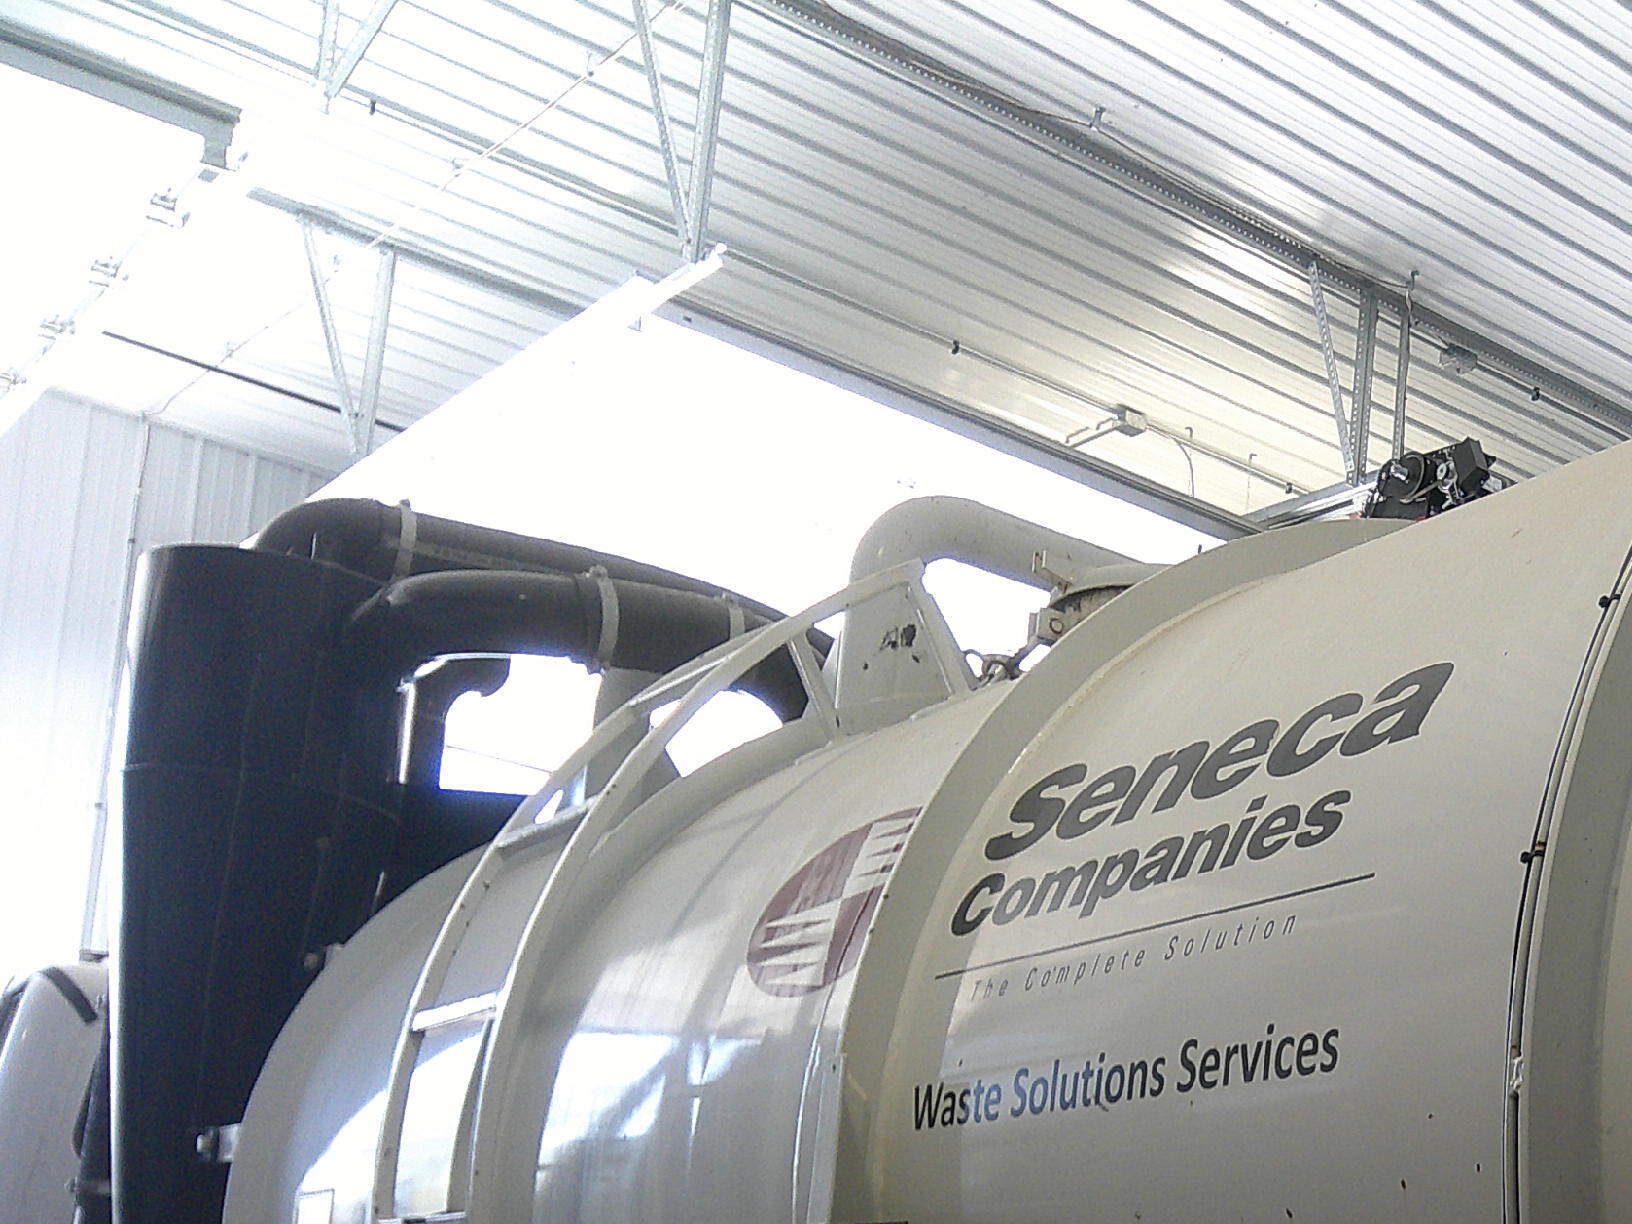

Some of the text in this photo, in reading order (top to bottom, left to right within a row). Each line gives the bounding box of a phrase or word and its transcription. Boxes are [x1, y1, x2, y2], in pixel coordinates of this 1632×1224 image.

[984, 661, 1454, 862] Seneca
[951, 789, 1351, 937] Companies
[970, 911, 1299, 1003] The Complete Solution
[912, 1023, 1341, 1131] Waste Solutions Services
